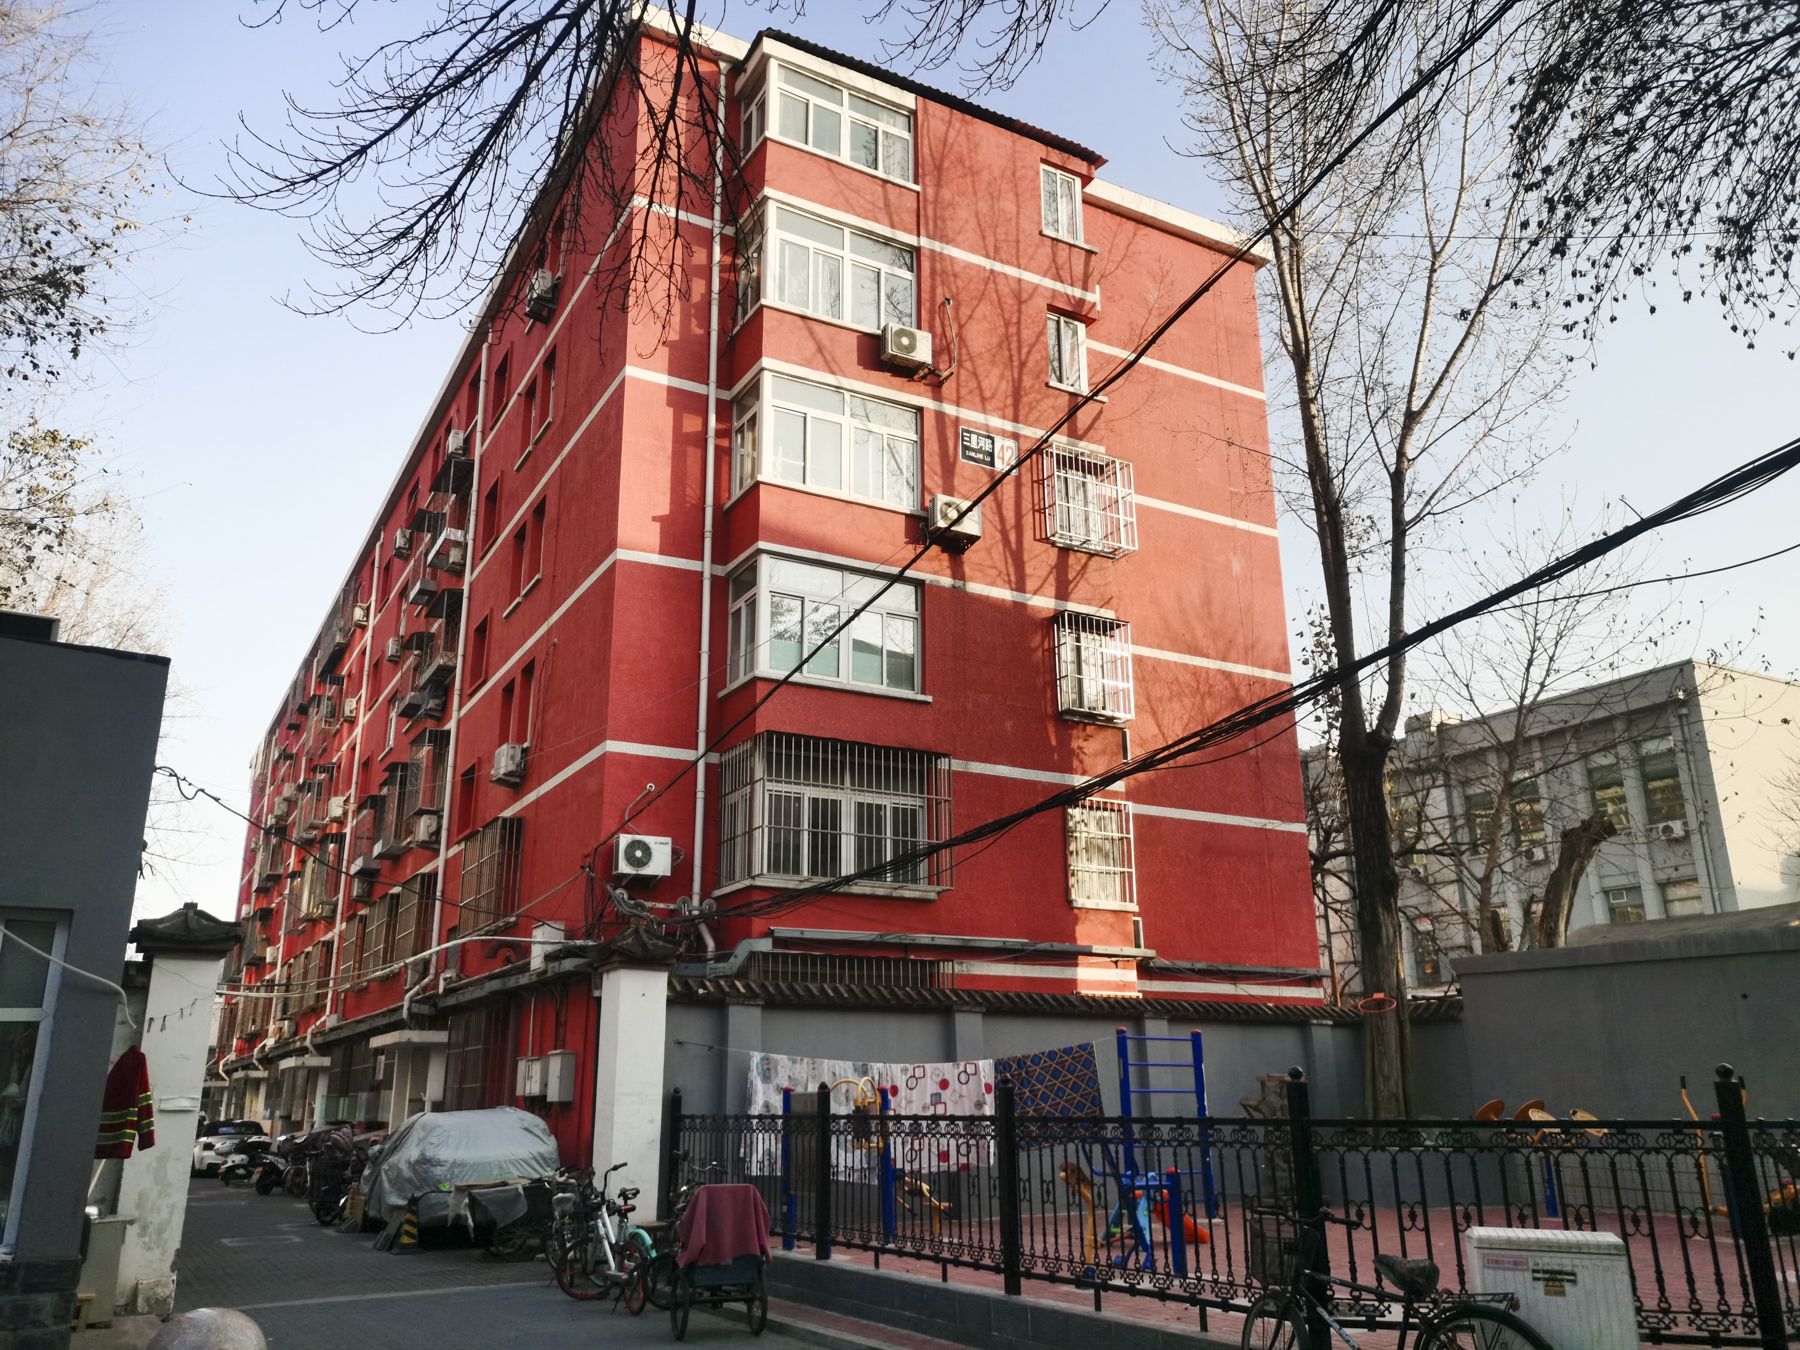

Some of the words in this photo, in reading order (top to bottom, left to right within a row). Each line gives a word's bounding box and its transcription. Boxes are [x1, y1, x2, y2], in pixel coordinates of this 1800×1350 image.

[963, 432, 993, 453] 三里河路
[997, 444, 1014, 466] 42
